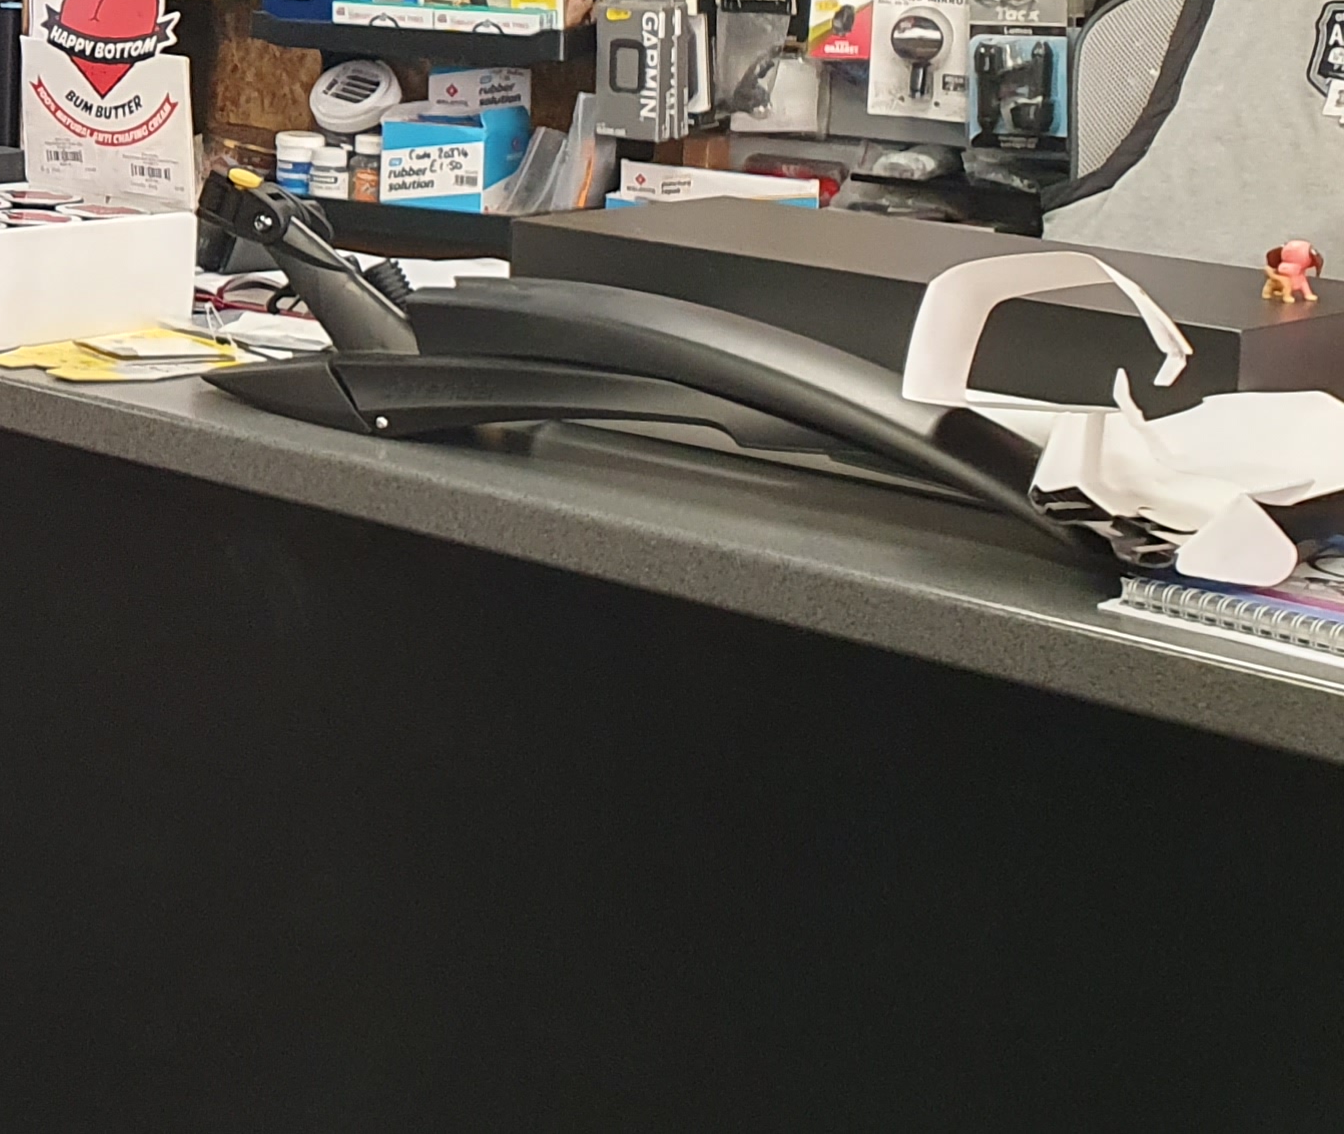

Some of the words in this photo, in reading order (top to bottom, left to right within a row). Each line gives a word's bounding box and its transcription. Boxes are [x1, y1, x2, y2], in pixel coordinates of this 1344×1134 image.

[50, 26, 93, 58] HAPPY
[95, 36, 158, 59] BOTTOM
[640, 11, 659, 119] GARMIN
[479, 82, 515, 96] rubber
[65, 90, 93, 117] BUM
[95, 95, 142, 119] BUTTER
[479, 93, 521, 108] solution
[37, 87, 56, 113] 100%
[56, 108, 90, 138] NATURAL
[93, 131, 112, 144] ANTI
[113, 125, 148, 144] CHAFING
[149, 103, 171, 132] CREAM
[388, 166, 427, 180] rubber
[388, 178, 434, 192] solution
